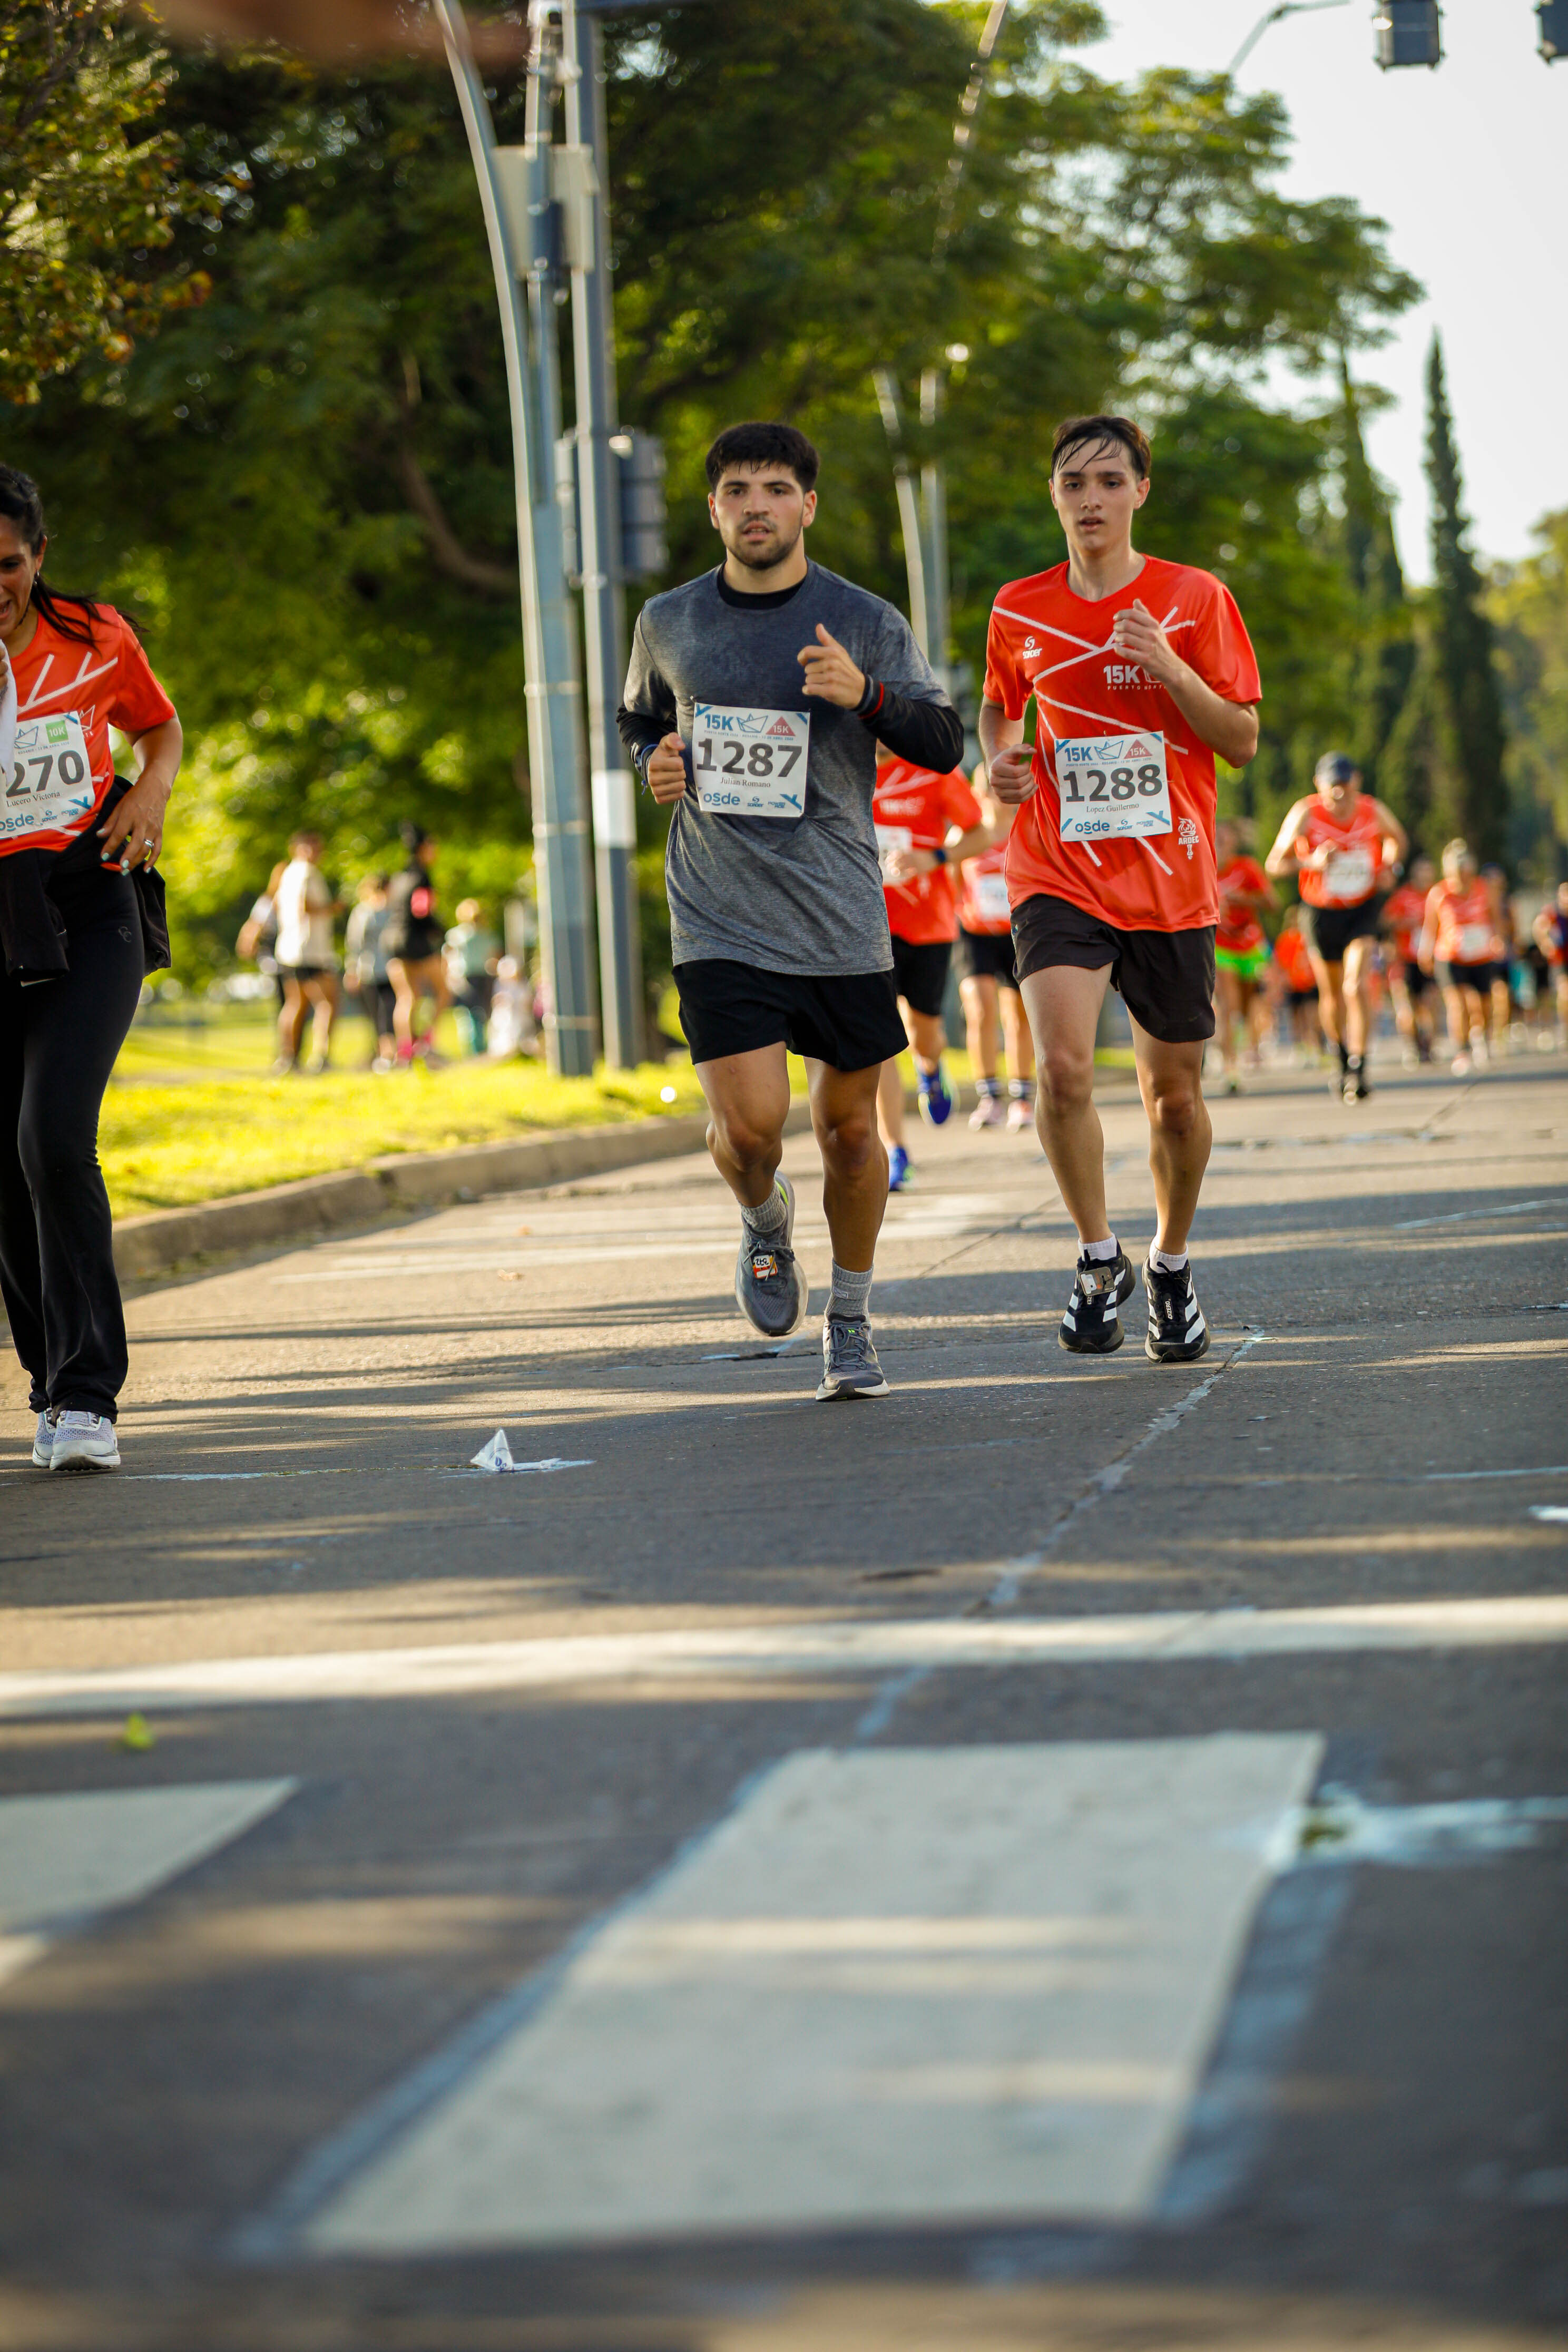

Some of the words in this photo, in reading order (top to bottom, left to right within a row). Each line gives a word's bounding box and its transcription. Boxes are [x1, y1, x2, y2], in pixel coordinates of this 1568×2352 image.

[1103, 665, 1141, 683] 15K
[704, 714, 734, 731] 15K
[48, 729, 65, 737] 10K
[697, 738, 802, 777] 1287
[1064, 747, 1093, 762] 15K
[1130, 748, 1146, 756] 15K
[5, 750, 84, 798] 270
[720, 777, 740, 786] Julian
[1063, 764, 1162, 802] 1288
[6, 797, 31, 807] Lucero
[32, 791, 61, 801] Victoria
[1086, 805, 1105, 814] Lopez
[1106, 803, 1139, 812] Guillermo
[1178, 835, 1199, 845] ARDEC
